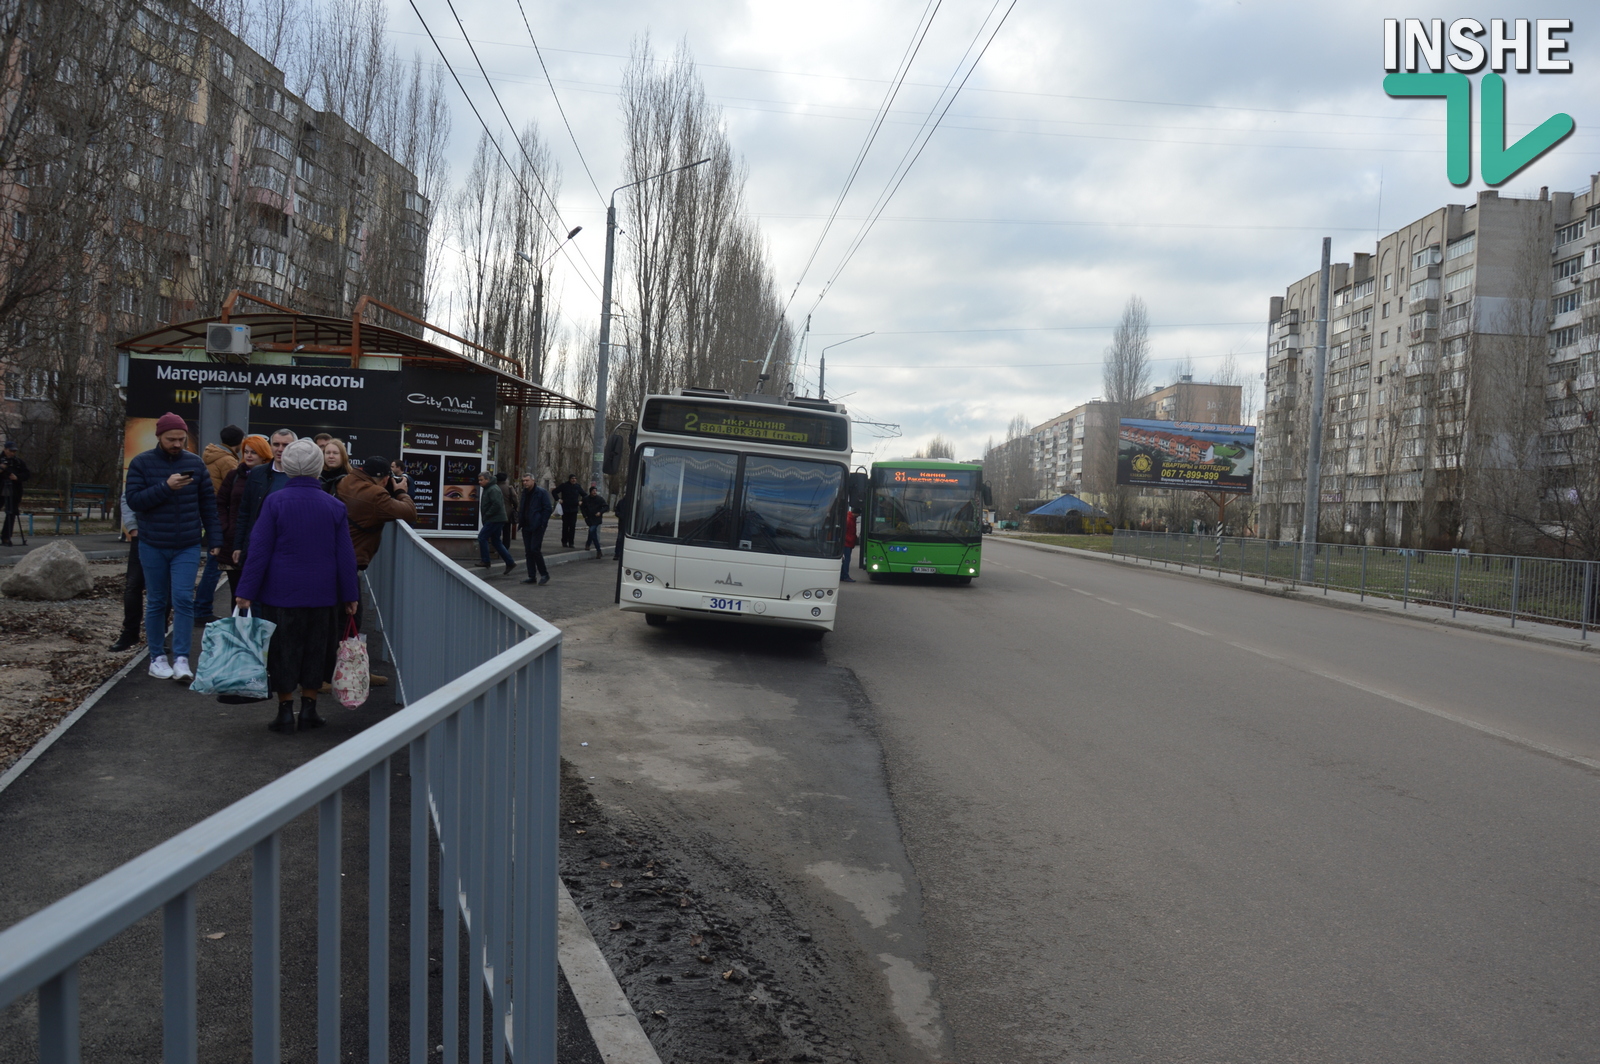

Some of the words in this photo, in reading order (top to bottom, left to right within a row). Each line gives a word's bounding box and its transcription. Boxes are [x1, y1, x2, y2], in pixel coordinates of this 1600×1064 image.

[156, 364, 252, 384] Материалы
[255, 371, 287, 387] для
[291, 373, 365, 390] красоты
[269, 395, 348, 412] качества
[406, 392, 442, 409] City
[441, 395, 474, 410] Nail
[684, 412, 699, 431] 2
[722, 419, 786, 430] мкр.НАМИВ
[454, 439, 474, 447] ПАСТЫ
[1162, 470, 1176, 478] 067
[1178, 471, 1220, 481] 7-899-899
[710, 598, 742, 611] 3011
